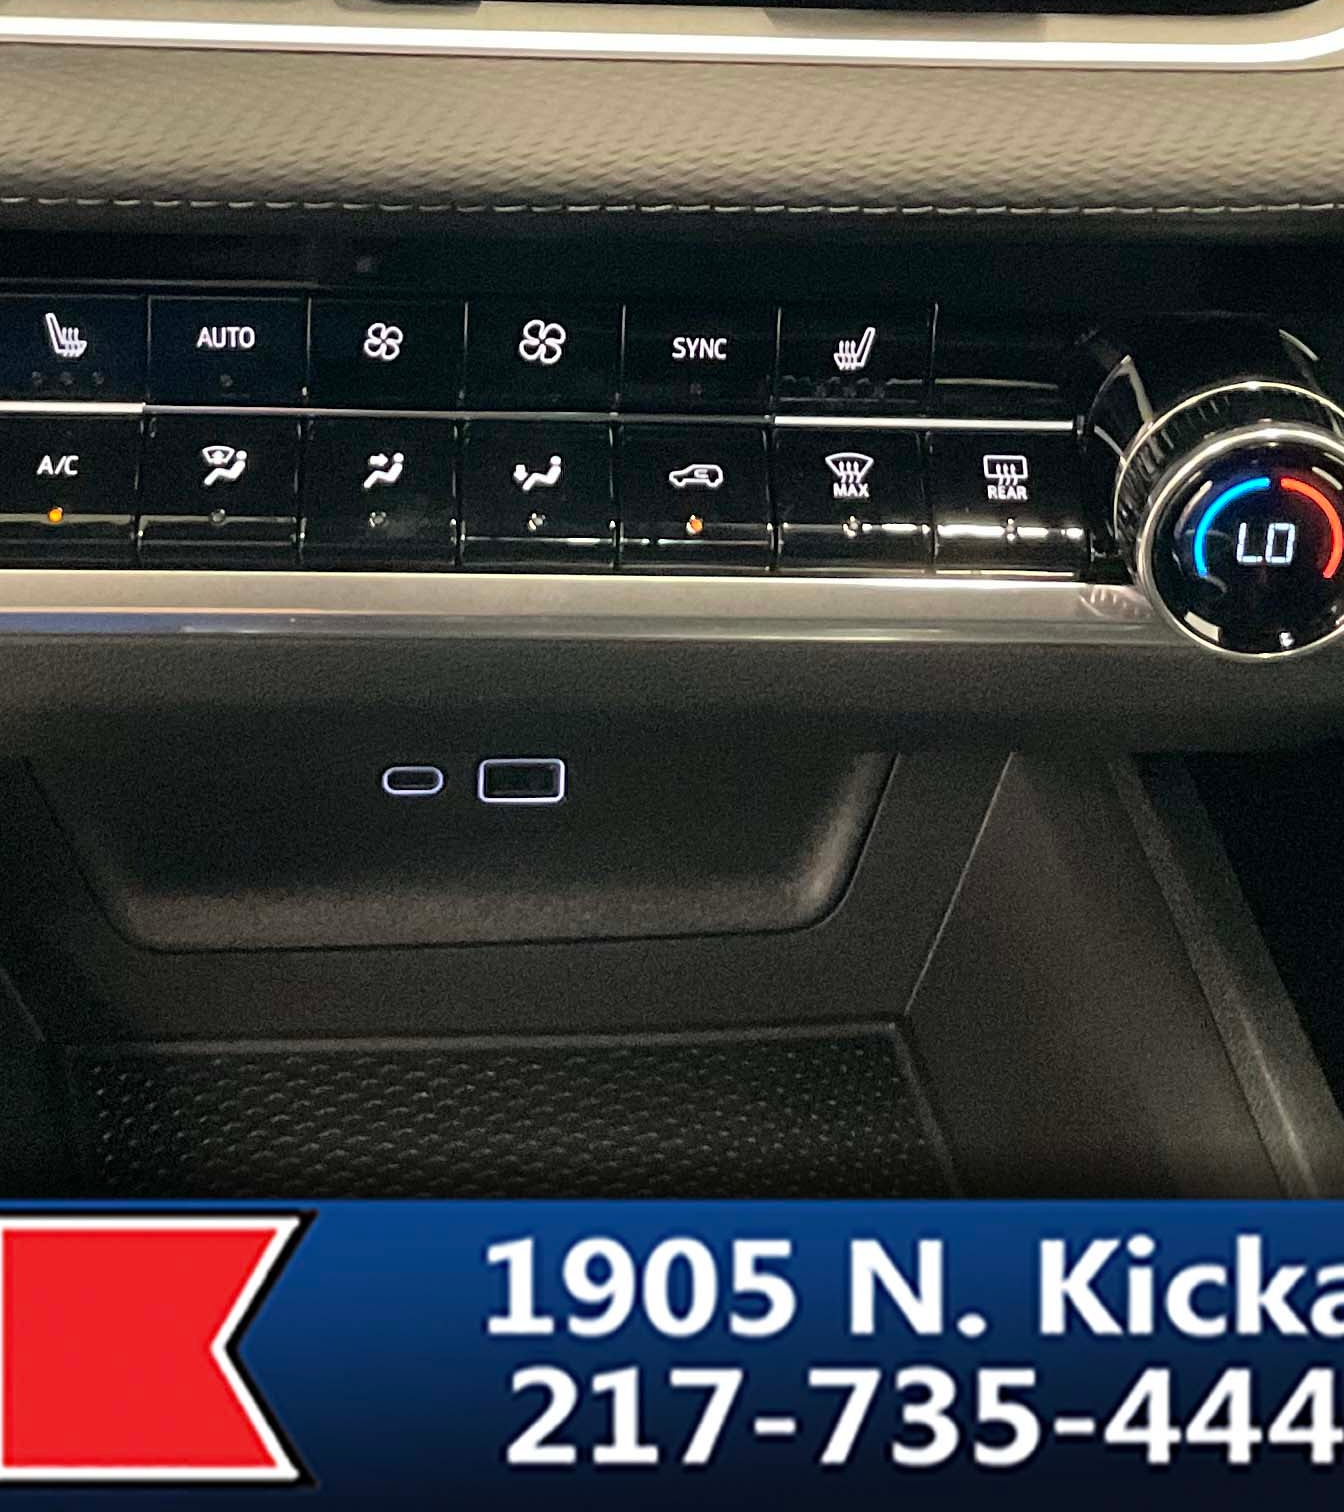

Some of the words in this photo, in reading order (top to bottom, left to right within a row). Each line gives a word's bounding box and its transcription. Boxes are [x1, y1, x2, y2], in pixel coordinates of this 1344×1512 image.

[196, 326, 256, 350] AUTO
[671, 337, 728, 361] SYNC
[36, 454, 80, 477] A/C
[832, 482, 870, 499] MAX
[987, 485, 1028, 501] REAR
[1236, 522, 1297, 564] LO
